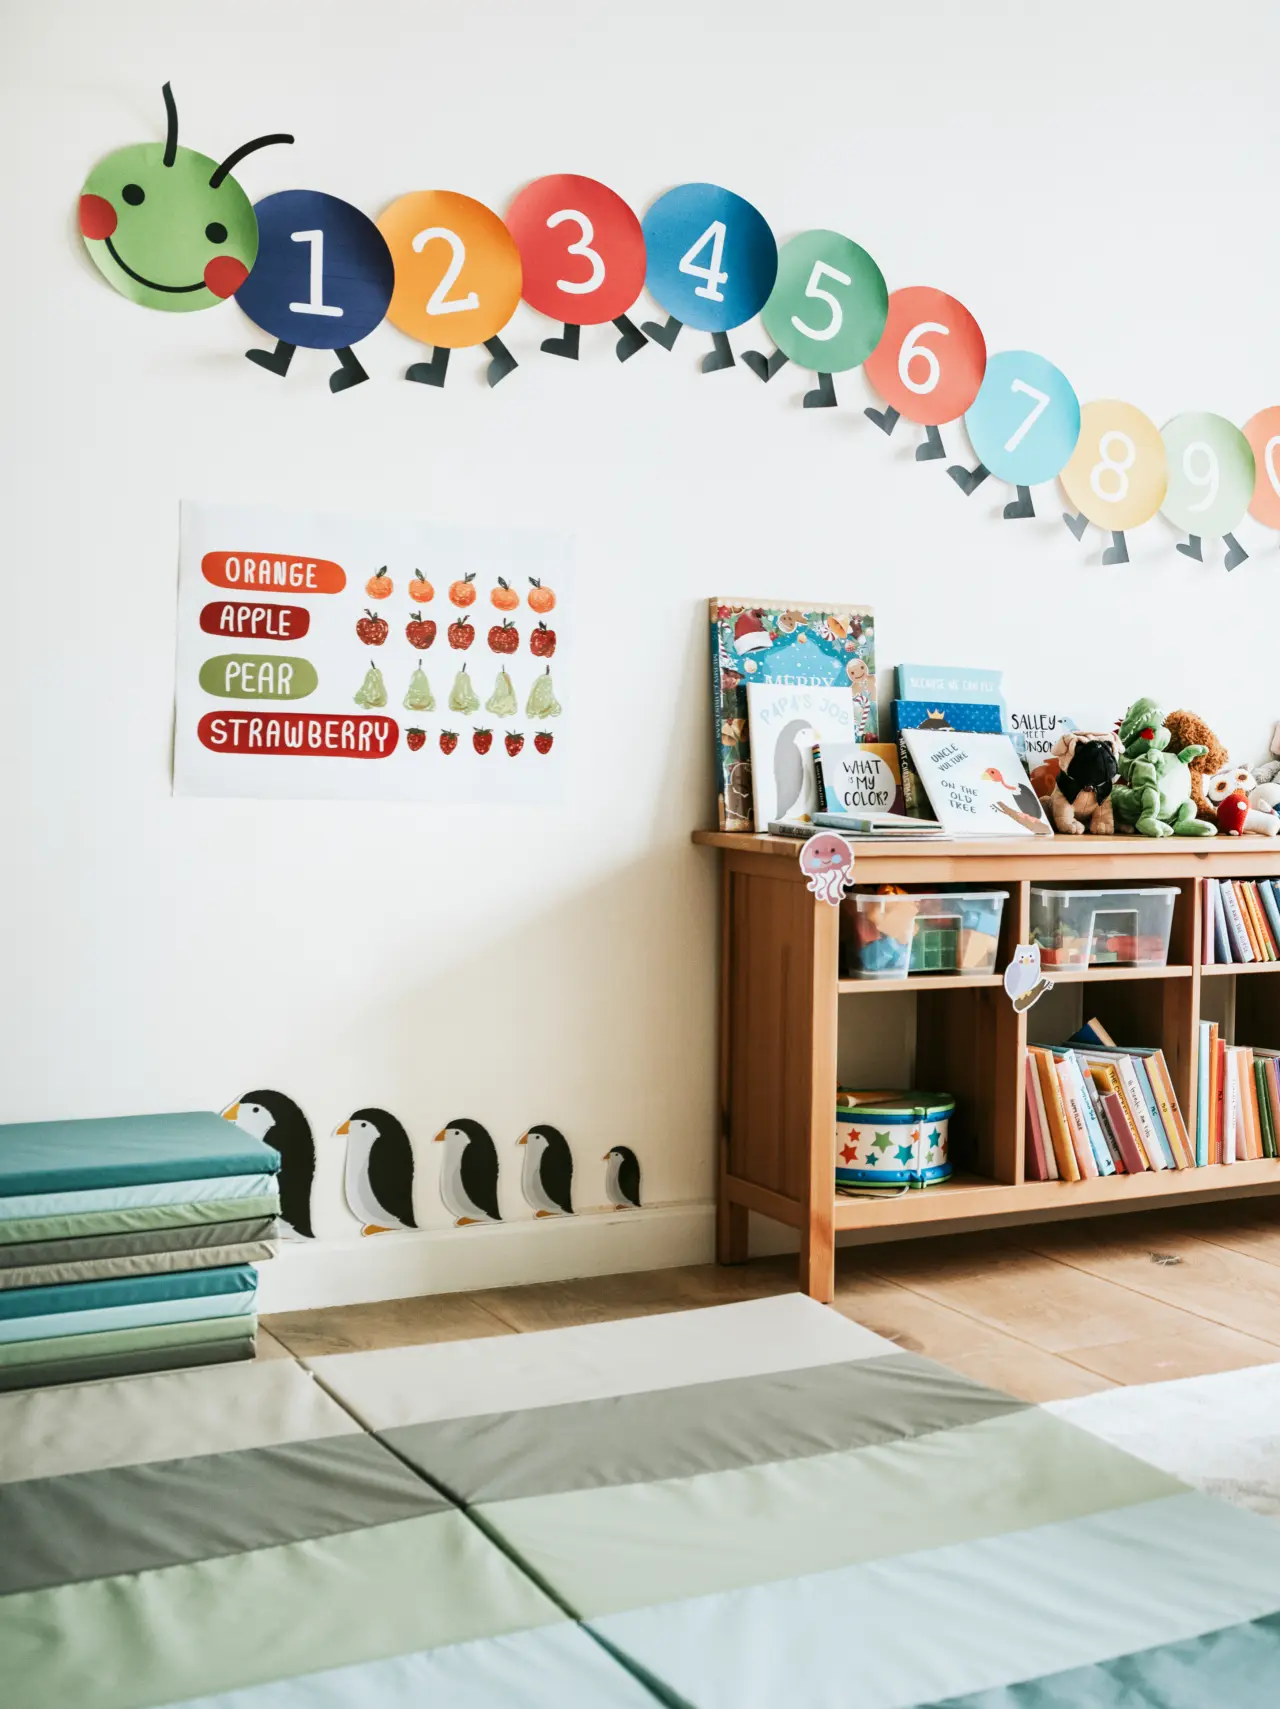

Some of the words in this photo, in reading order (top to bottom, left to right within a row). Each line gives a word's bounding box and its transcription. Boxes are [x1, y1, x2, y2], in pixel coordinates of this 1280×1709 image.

[290, 229, 344, 317] 1
[412, 227, 480, 316] 2
[546, 209, 606, 295] 3
[679, 220, 729, 302] 4
[790, 259, 852, 342] 5
[897, 321, 951, 395] 6
[1003, 378, 1051, 453] 7
[1089, 430, 1136, 502] 8
[1182, 440, 1220, 513] 9
[225, 556, 318, 589] ORANGE
[219, 604, 292, 636] APPLE
[225, 661, 294, 695] PEAR
[819, 697, 850, 726] JOB
[1011, 713, 1057, 731] SALLEY
[210, 718, 389, 753] STRAWBERRY
[930, 743, 959, 763] UNCLE
[938, 751, 968, 772] VULTURE
[843, 760, 881, 775] WHAT
[856, 775, 876, 790] MY
[941, 780, 955, 790] ON
[960, 785, 978, 797] THE
[844, 791, 889, 806] COLOR?
[949, 799, 977, 814] TREE
[950, 791, 973, 804] OLD
[1109, 1071, 1118, 1085] THE
